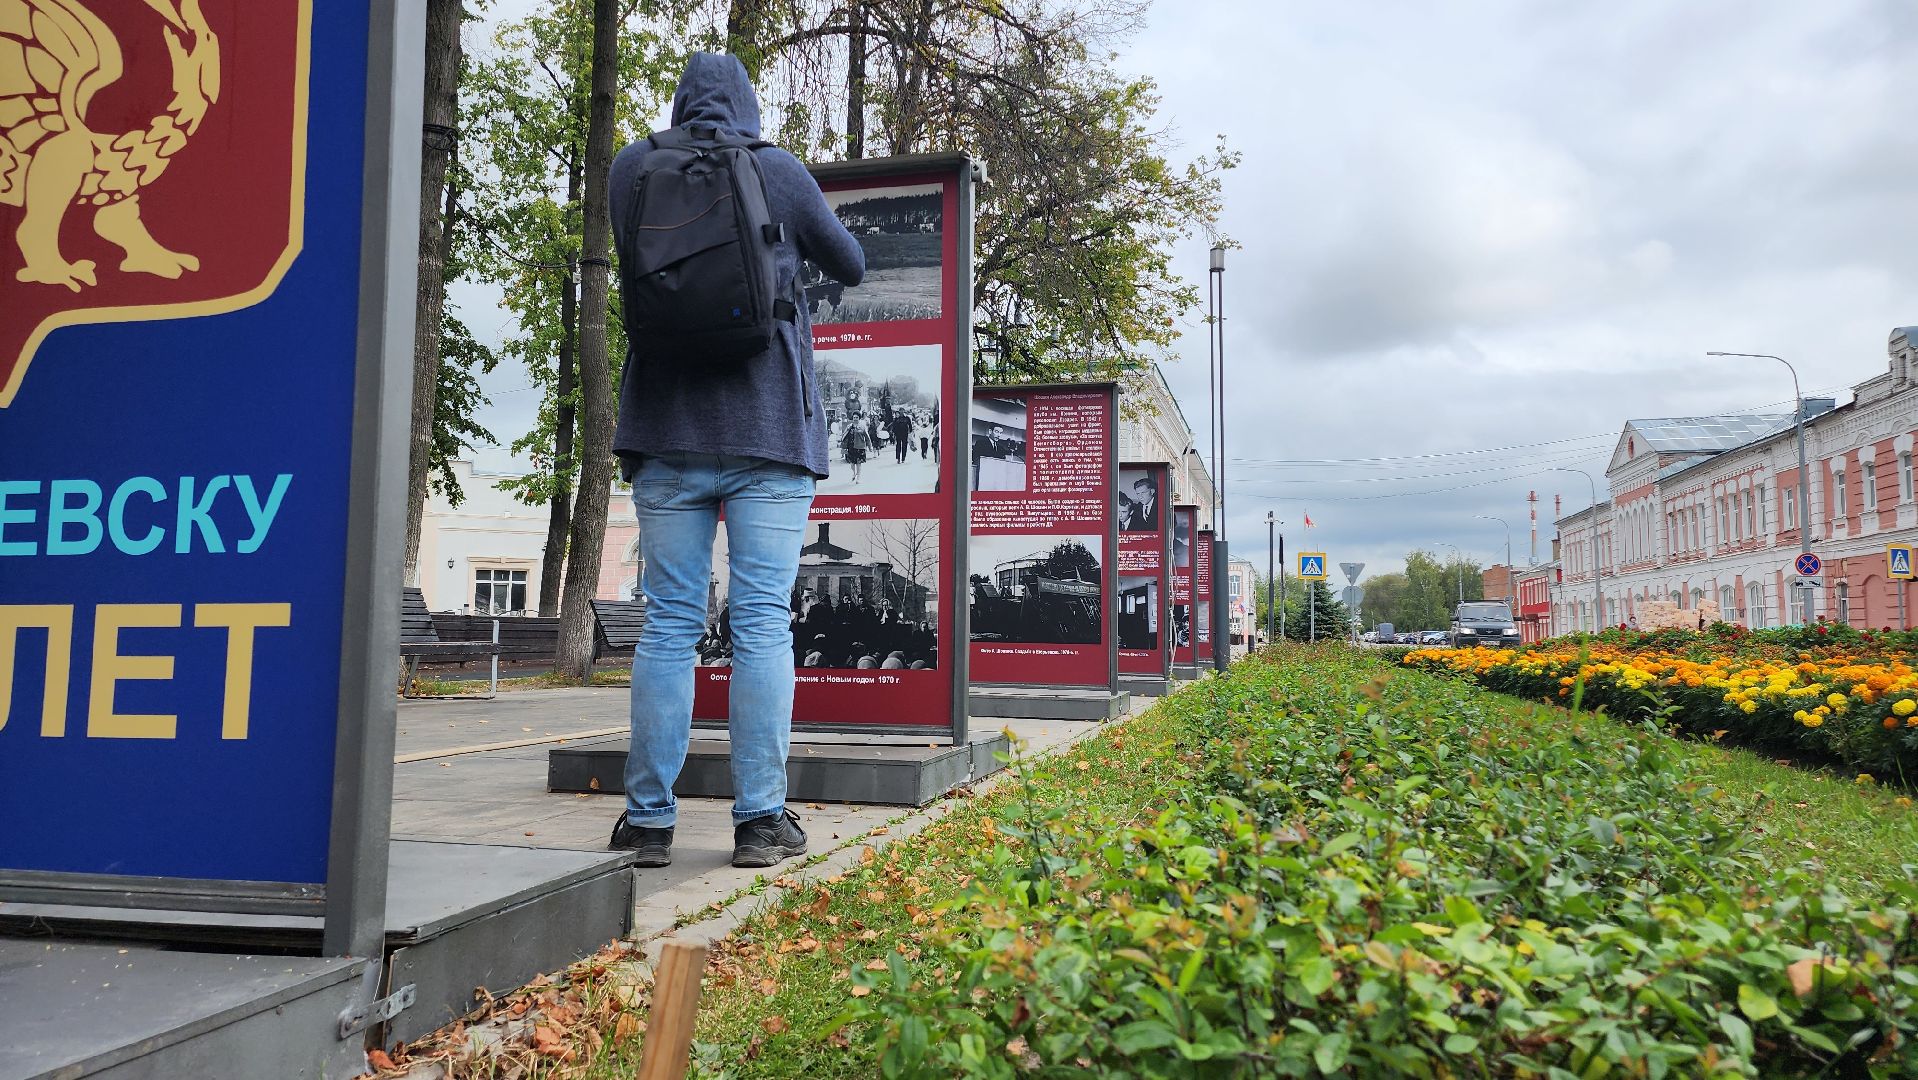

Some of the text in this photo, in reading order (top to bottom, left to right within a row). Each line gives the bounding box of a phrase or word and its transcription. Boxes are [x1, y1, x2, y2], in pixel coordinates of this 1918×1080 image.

[0, 474, 293, 555] ЕВСКУ
[808, 507, 853, 516] монстрация.
[854, 504, 870, 513] 1980
[0, 603, 292, 740] ЛЕТ
[826, 674, 851, 682] Новым
[878, 676, 894, 684] 1970
